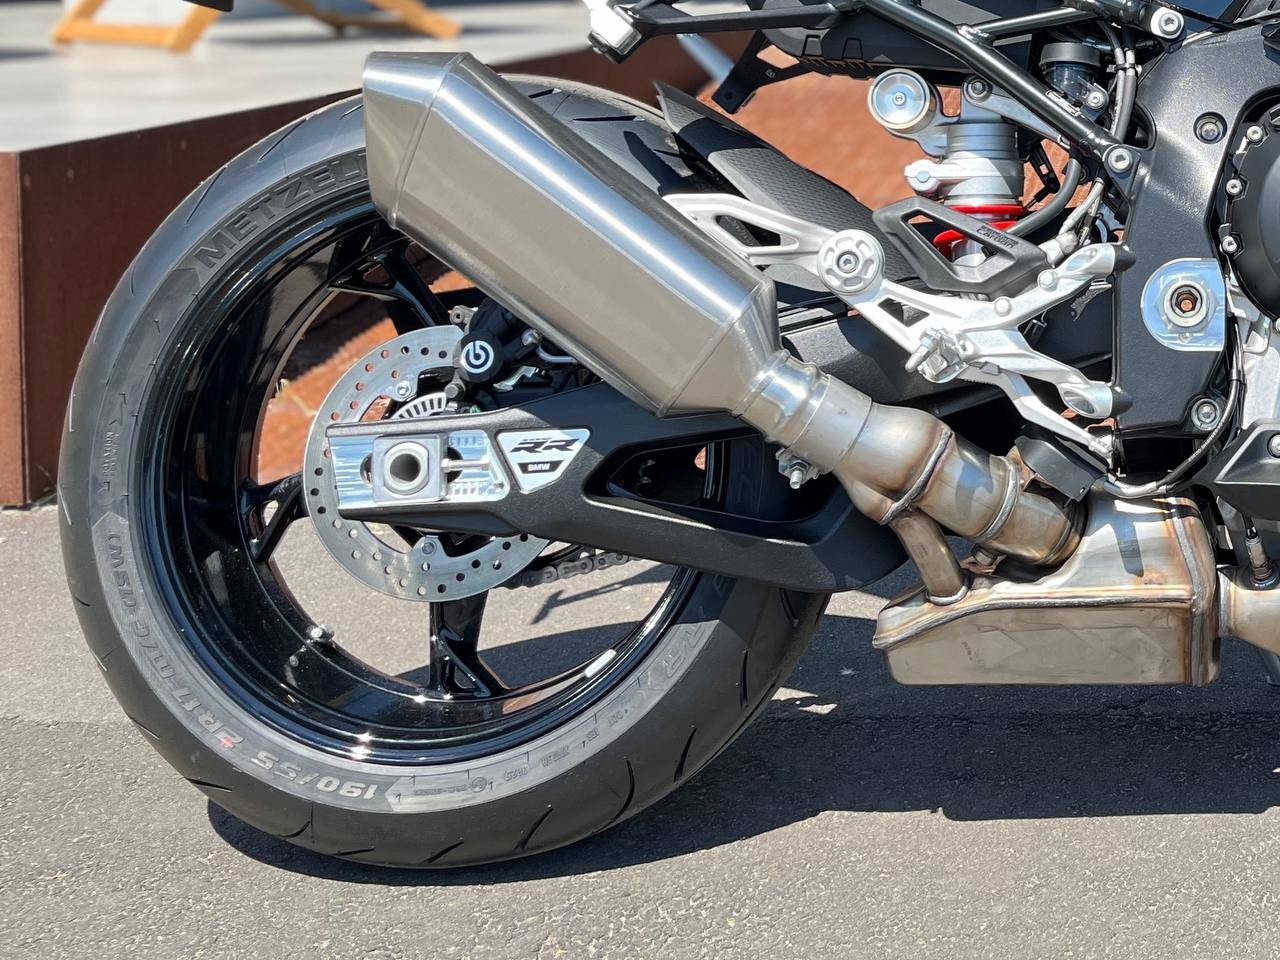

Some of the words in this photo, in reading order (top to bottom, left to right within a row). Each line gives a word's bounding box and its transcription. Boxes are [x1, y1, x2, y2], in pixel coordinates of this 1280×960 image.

[192, 151, 368, 269] METZEL
[509, 439, 580, 454] RR
[527, 463, 551, 472] BMW
[250, 750, 380, 800] 190/55
